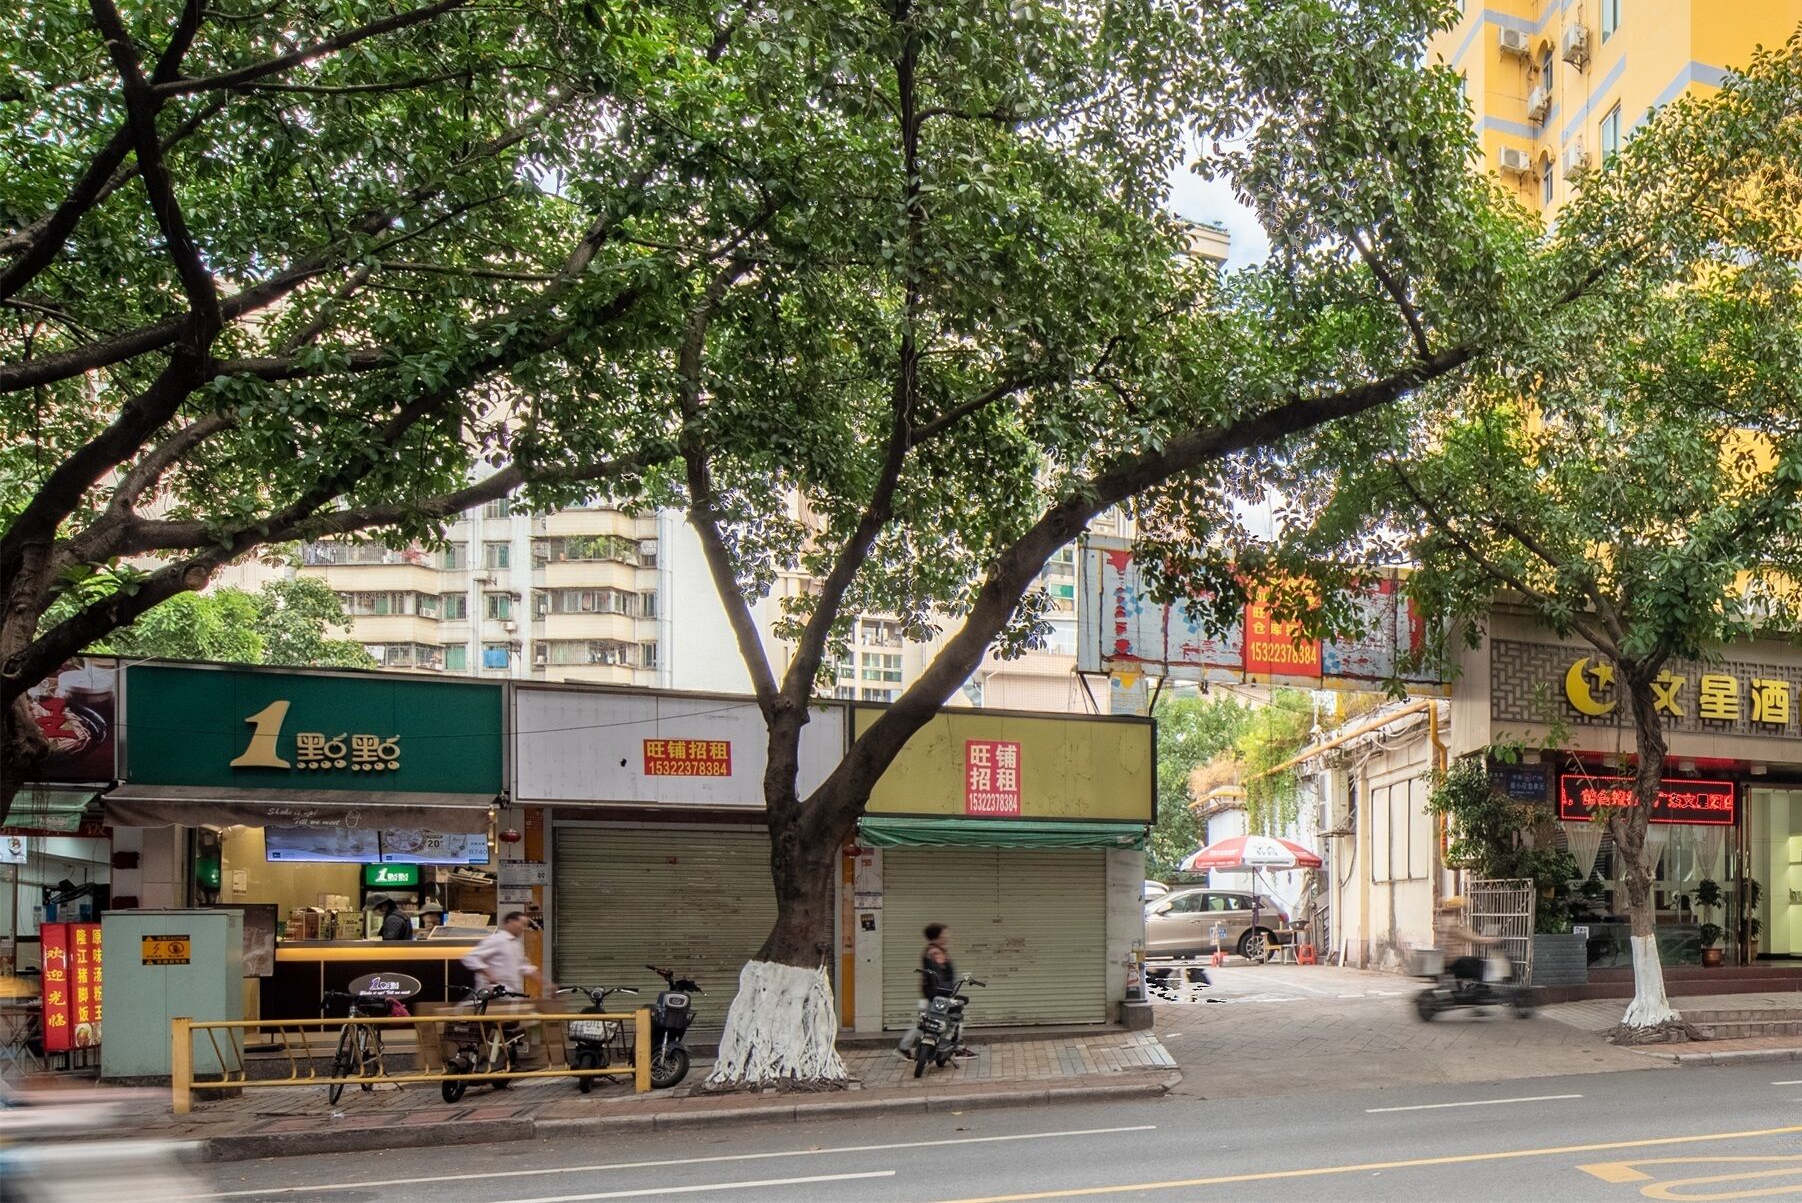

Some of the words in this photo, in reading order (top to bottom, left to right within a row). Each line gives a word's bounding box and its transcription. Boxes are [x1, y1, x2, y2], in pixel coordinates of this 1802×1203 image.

[1250, 641, 1317, 665] 15322378384
[646, 740, 728, 759] 旺铺招租
[970, 744, 1017, 768] 旺铺
[649, 761, 727, 775] 15322378384
[969, 767, 1018, 791] 招租
[969, 793, 1018, 812] 15322378384
[46, 946, 66, 1028] 欢迎光临
[75, 928, 89, 1023] 隆江猪脚饭
[92, 929, 102, 1021] 原味汤粉王
